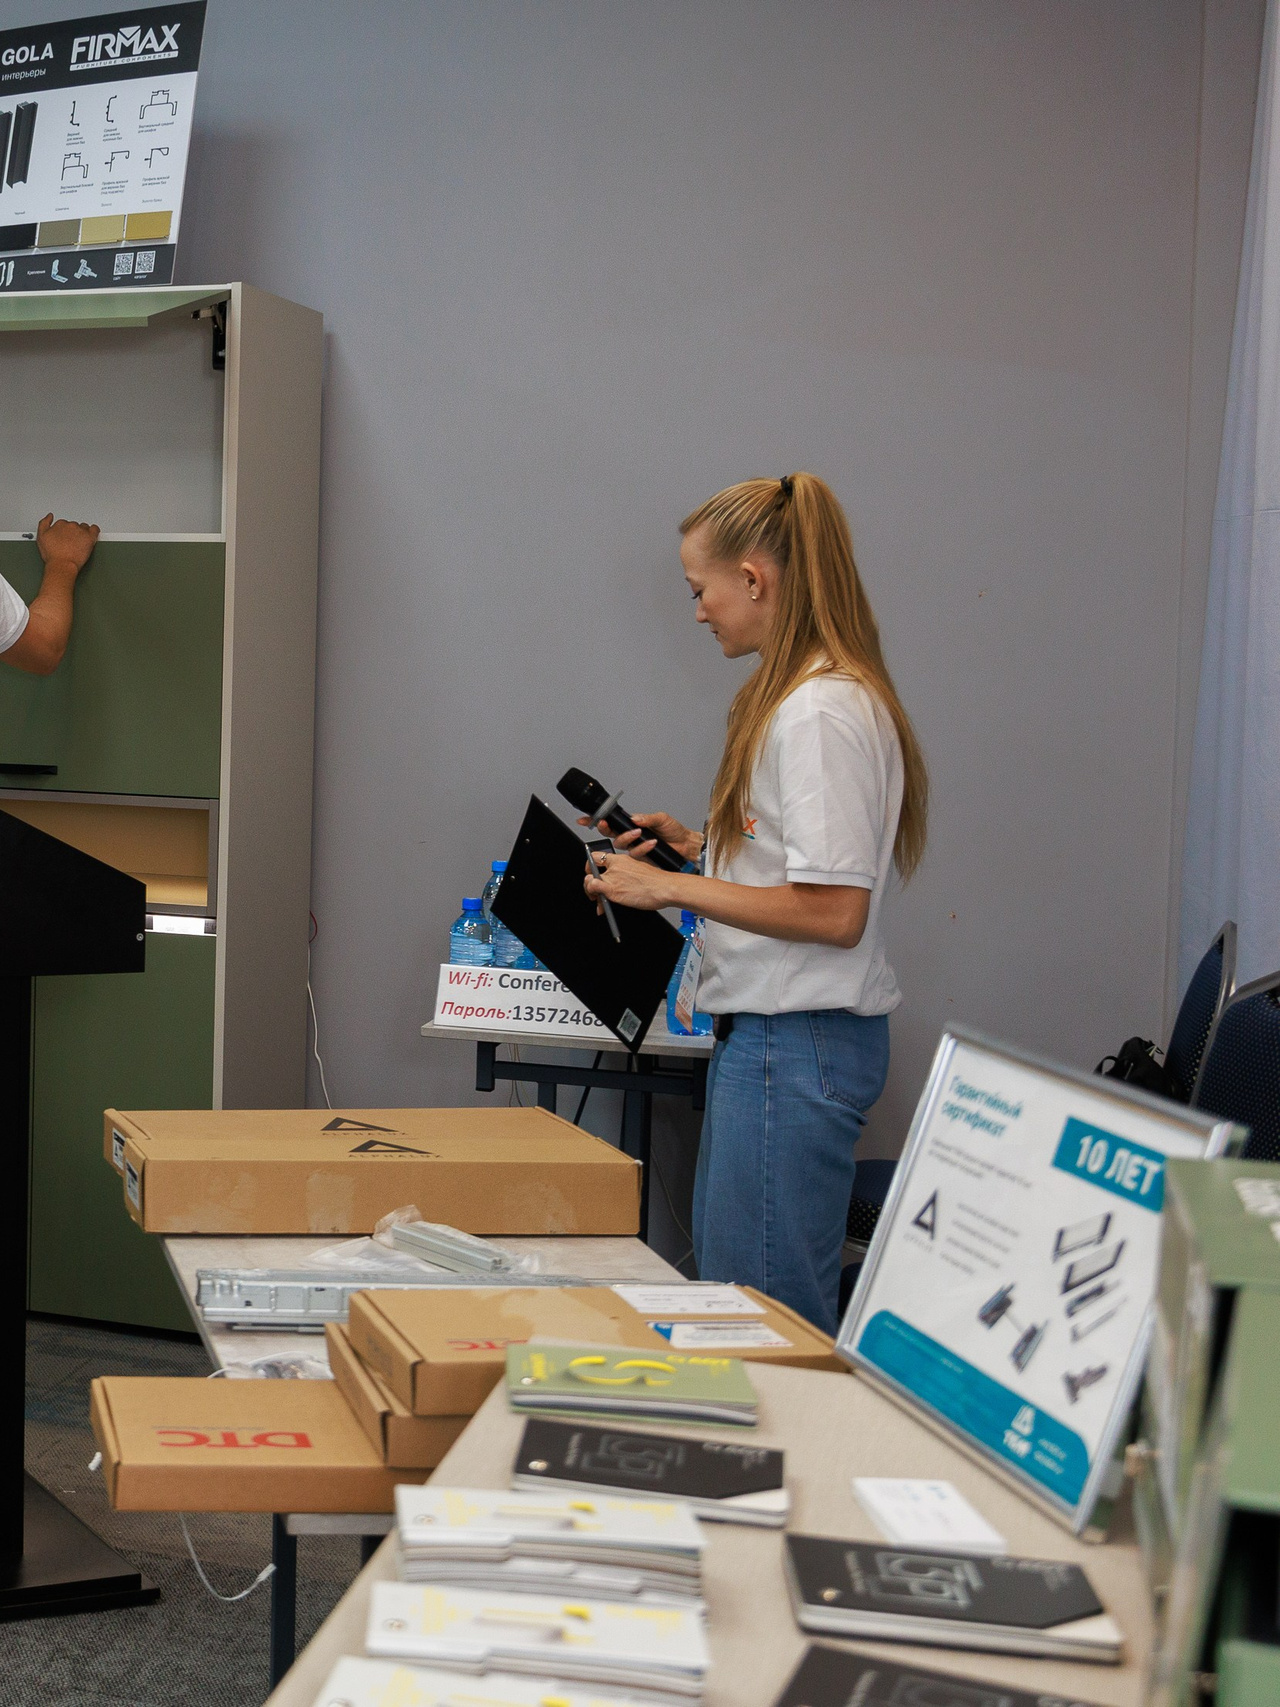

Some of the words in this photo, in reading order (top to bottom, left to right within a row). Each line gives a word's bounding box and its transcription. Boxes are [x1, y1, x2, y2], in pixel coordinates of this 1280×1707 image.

[1, 42, 54, 66] GOLA
[70, 23, 181, 64] FIRMAX
[76, 59, 117, 69] FURNITURE
[121, 53, 171, 64] COMPONENTS
[1, 68, 46, 81] интерьеры
[448, 970, 494, 990] Wi-fi:
[498, 973, 571, 993] Confere
[1075, 1134, 1109, 1175] 10
[1103, 1147, 1162, 1196] ЛЕТ
[156, 1430, 313, 1449] DTC
